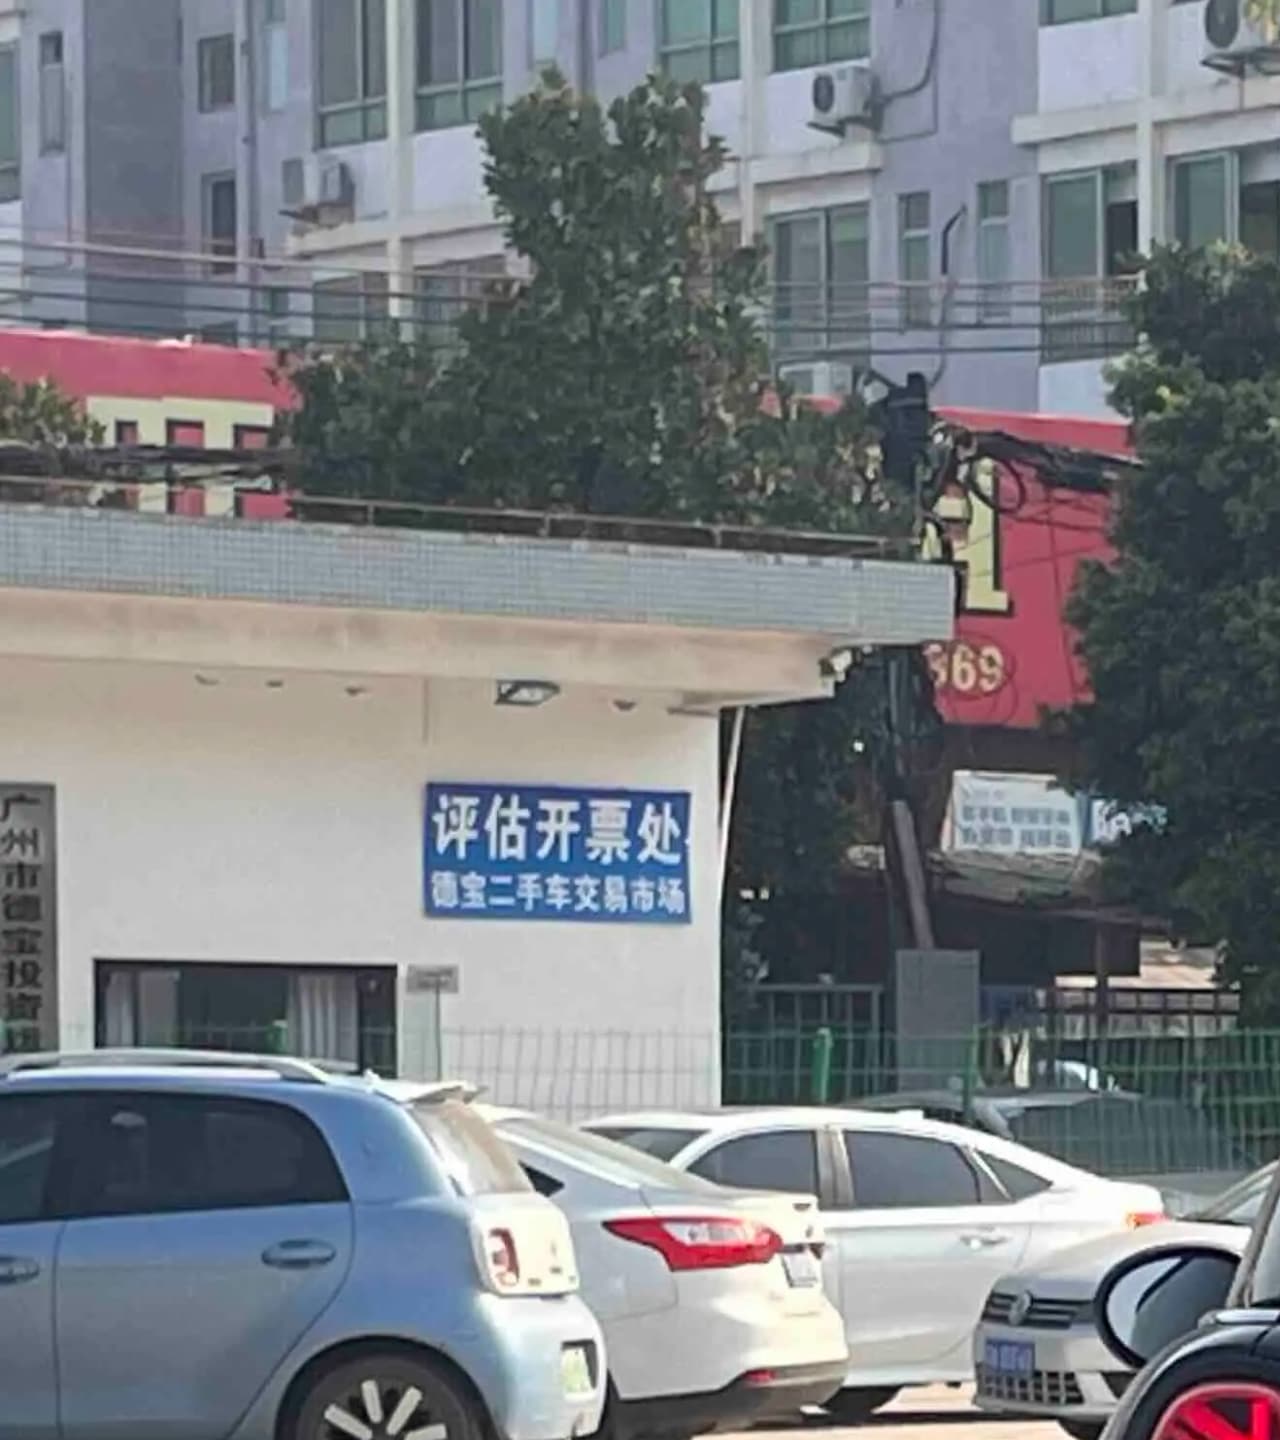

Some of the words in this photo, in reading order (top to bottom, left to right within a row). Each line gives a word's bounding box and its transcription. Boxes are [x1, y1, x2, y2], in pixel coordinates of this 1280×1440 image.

[432, 794, 681, 864] 评估开票处
[431, 871, 686, 913] 德宝二手车交易市场
